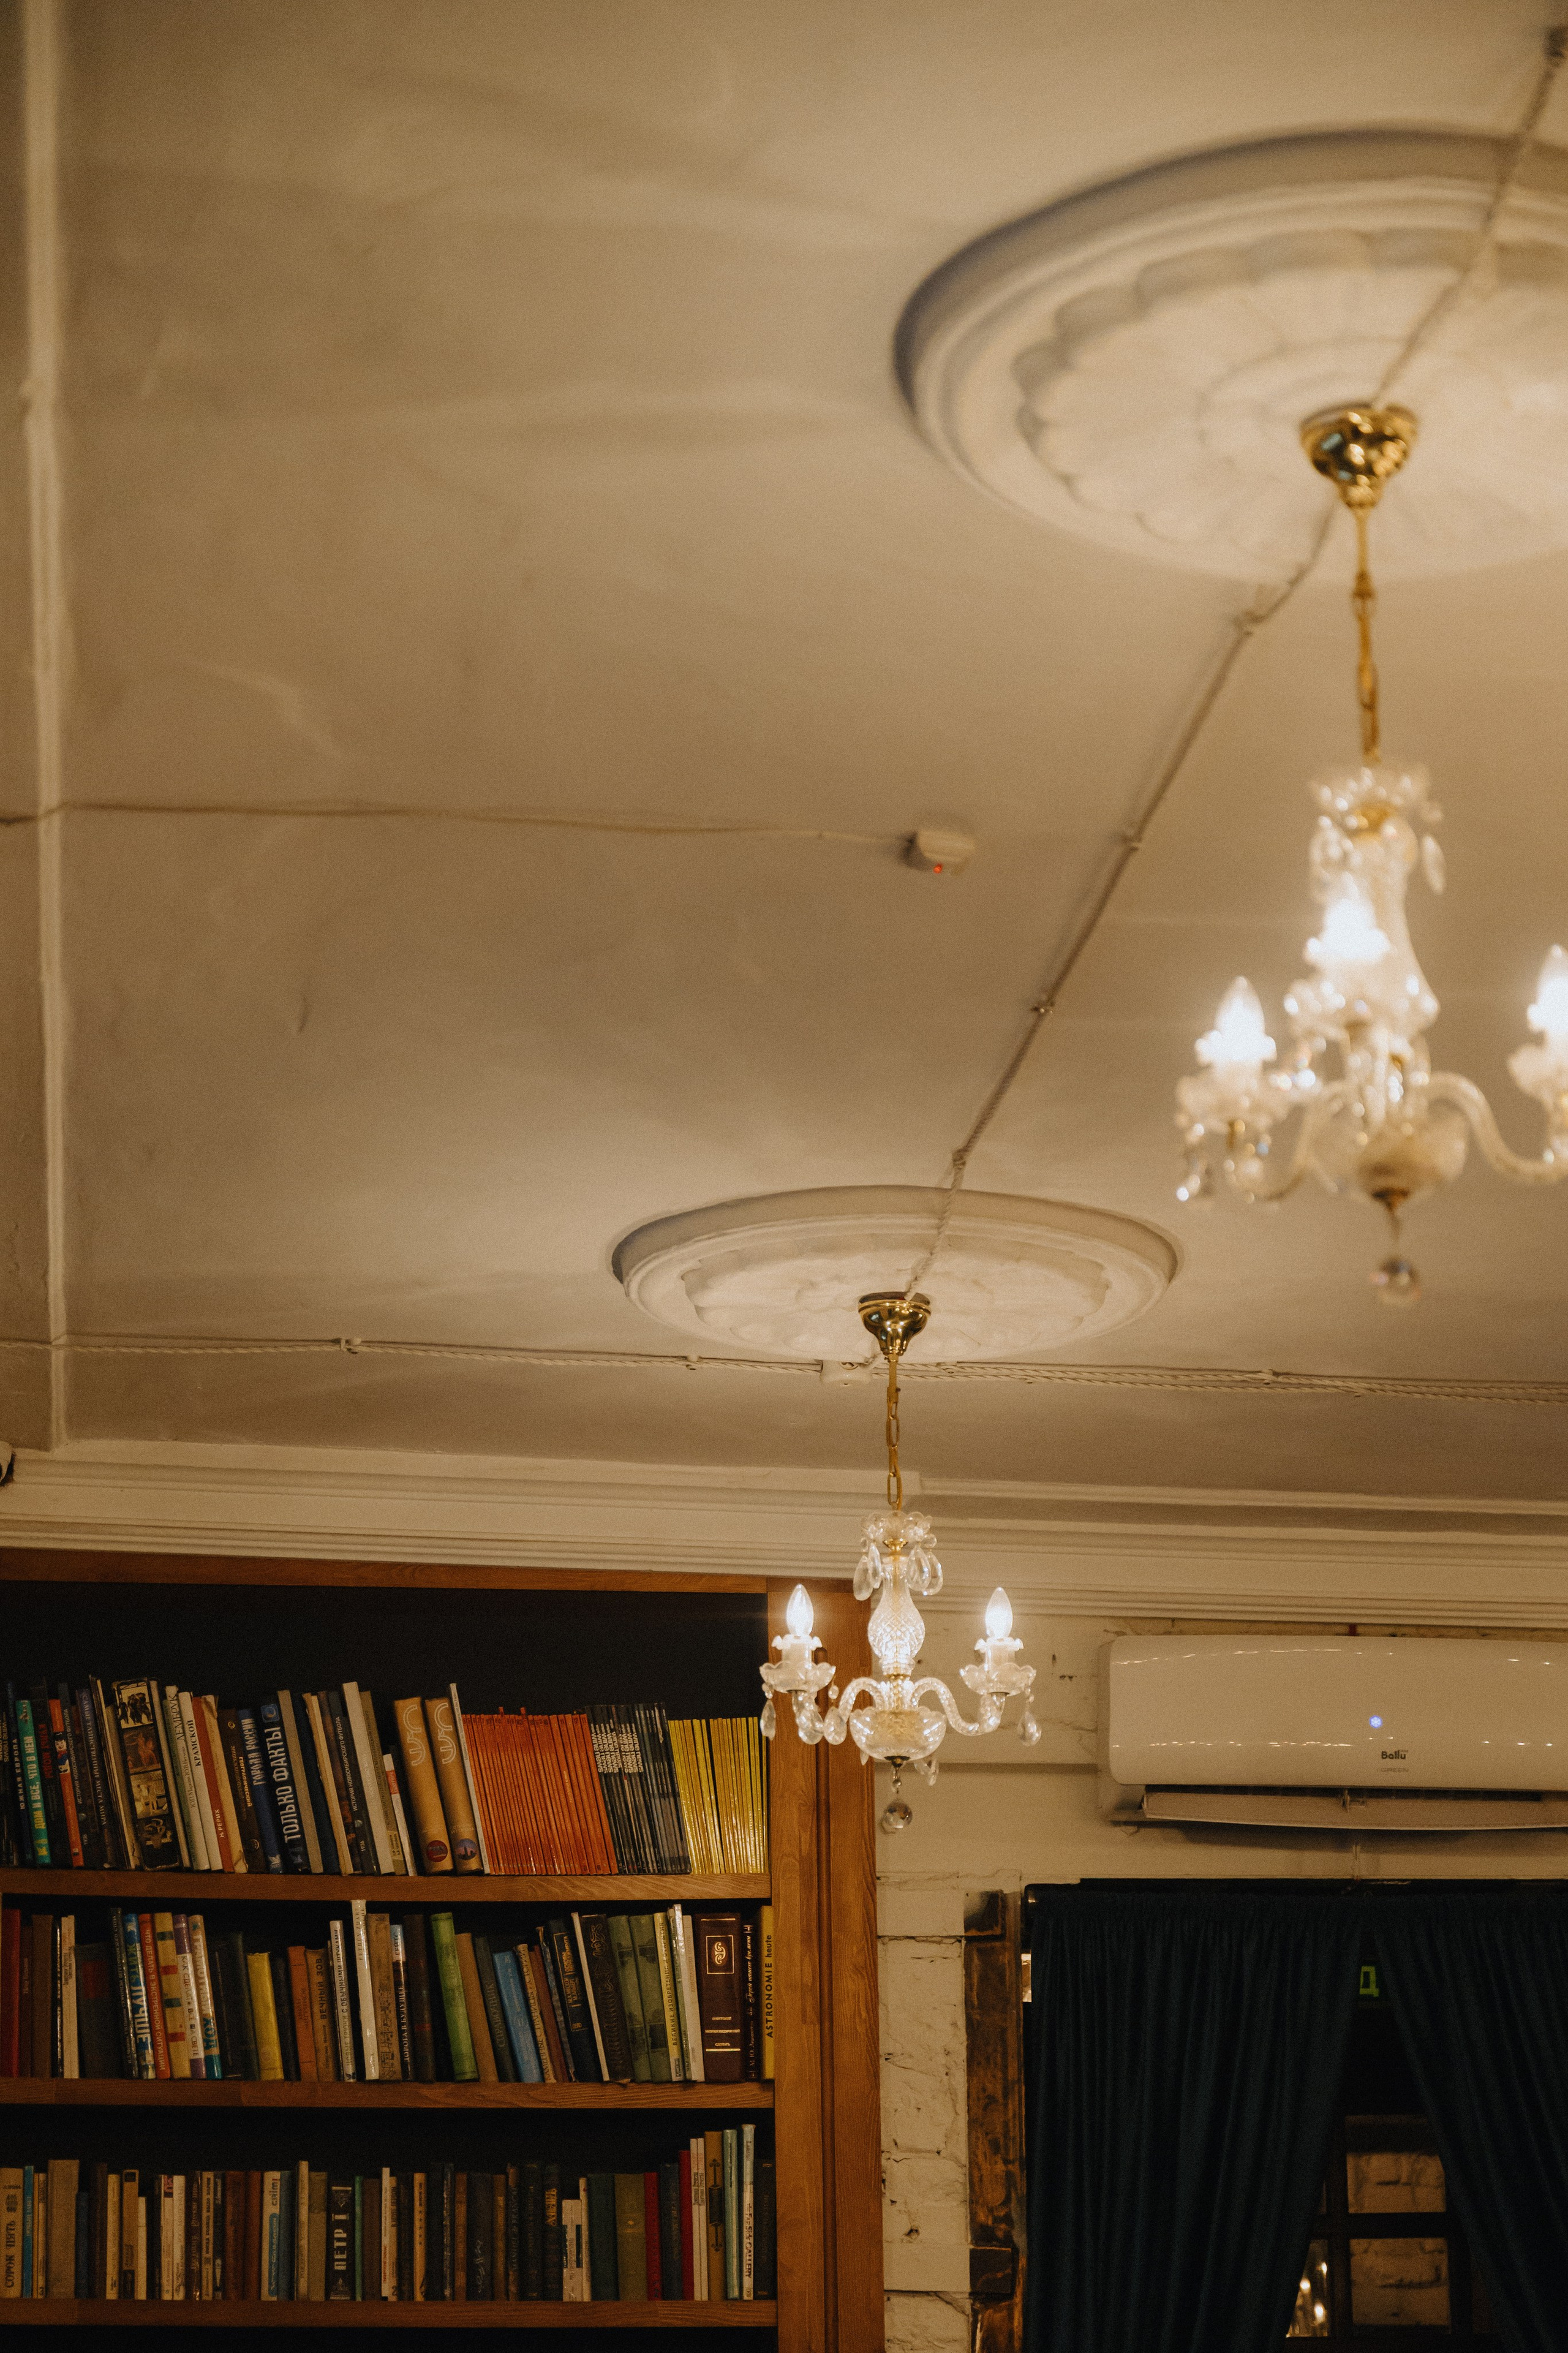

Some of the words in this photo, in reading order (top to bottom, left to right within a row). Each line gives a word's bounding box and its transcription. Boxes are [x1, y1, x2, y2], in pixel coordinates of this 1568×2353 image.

[63, 1709, 72, 1734] ФУТБОЛА
[81, 1694, 90, 1720] САМЫЕ
[168, 1694, 186, 1741] ЛЕМБРУК
[23, 1735, 35, 1753] НЕМ
[38, 1723, 50, 1751] КУЛЬТ
[186, 1719, 202, 1767] КРАМСКОЙ
[241, 1718, 260, 1751] РОССИИ
[335, 1716, 345, 1740] ФУТБОЛА
[12, 1738, 21, 1773] ЕВРОПА
[26, 1754, 36, 1762] В
[42, 1753, 54, 1779] МОДЫ
[66, 1733, 80, 1778] НОВОСИБИРСКОГО
[248, 1751, 266, 1786] ГОРОДА
[263, 1726, 290, 1783] ФАКТЫ
[340, 1740, 355, 1787] НОВОСИБИРСКОГО
[1381, 1750, 1406, 1759] Ballu
[28, 1766, 39, 1780] ЧТО
[238, 1756, 252, 1808] ГЕОГРАФИЧЕСКИЙ
[16, 1777, 26, 1810] ЮЖНАЯ
[30, 1781, 41, 1800] ВСЕ,
[73, 1778, 83, 1805] ИСТОРИЯ
[94, 1780, 104, 1803] МЕСТА
[349, 1787, 358, 1811] ИСТОРИЯ
[33, 1810, 47, 1829] ДОМ
[98, 1805, 107, 1826] МИРА
[274, 1785, 301, 1843] ТОЛЬКО
[334, 1928, 343, 1963] ШТУКАМИ
[126, 1943, 139, 1983] ЖИТЬ
[193, 1935, 210, 2014] ГРАМОТНЫЙ
[203, 2017, 218, 2051] ХОД
[318, 1981, 328, 2020] ВЕЧНЫЙ
[337, 1965, 348, 2007] ОБЫЧНЫМИ
[663, 1967, 674, 2012] ИЗОБРЕТЕНИЯ
[130, 1985, 152, 2044] ЛУЧШЕ
[151, 1981, 160, 2030] ЭКСТРЕННОЙ
[156, 2031, 165, 2071] СИТУАЦИИ
[343, 2015, 352, 2039] ТРЮКИ
[488, 1981, 505, 2048] СПРАВОЧНИК
[669, 2013, 678, 2046] ВЕЛИКИЕ
[190, 2034, 200, 2057] СВЕТЕ
[6, 2221, 15, 2248] ПЯТЬ
[333, 2228, 347, 2270] ПЕТР
[4, 2254, 15, 2288] СОРОК
